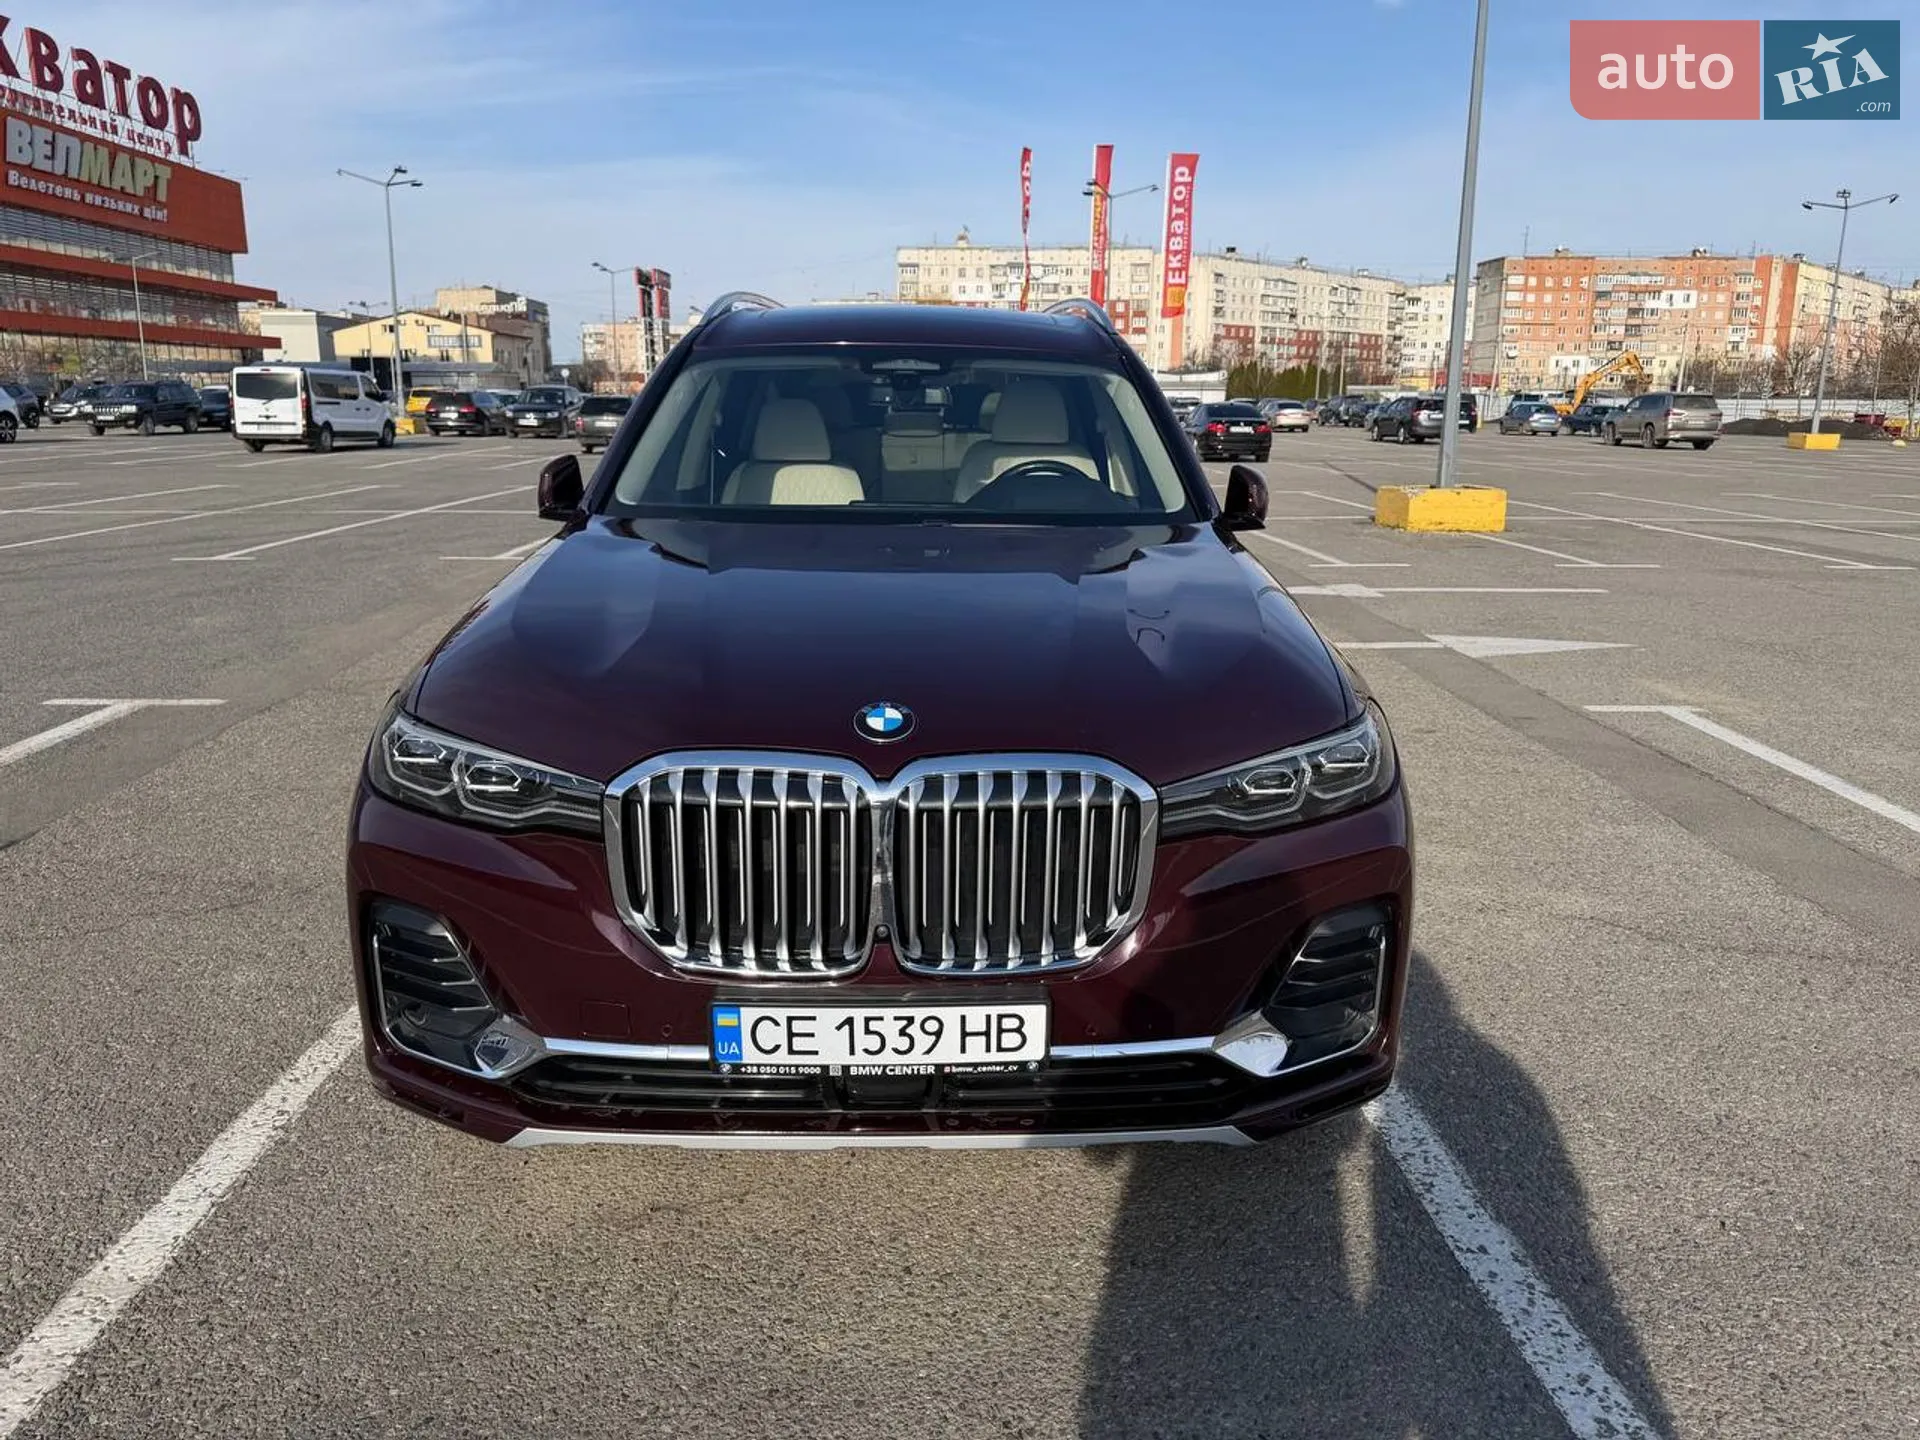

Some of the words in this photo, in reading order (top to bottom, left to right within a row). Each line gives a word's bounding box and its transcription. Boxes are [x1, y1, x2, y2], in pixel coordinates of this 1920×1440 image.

[7, 170, 81, 202] Велетень
[84, 191, 141, 216] низьких
[750, 1015, 820, 1056] CE
[834, 1015, 945, 1057] 1539
[959, 1013, 1028, 1054] HB
[718, 1042, 739, 1055] UA
[798, 1066, 821, 1075] 9000
[850, 1065, 883, 1076] BMW
[885, 1064, 935, 1075] CENTER
